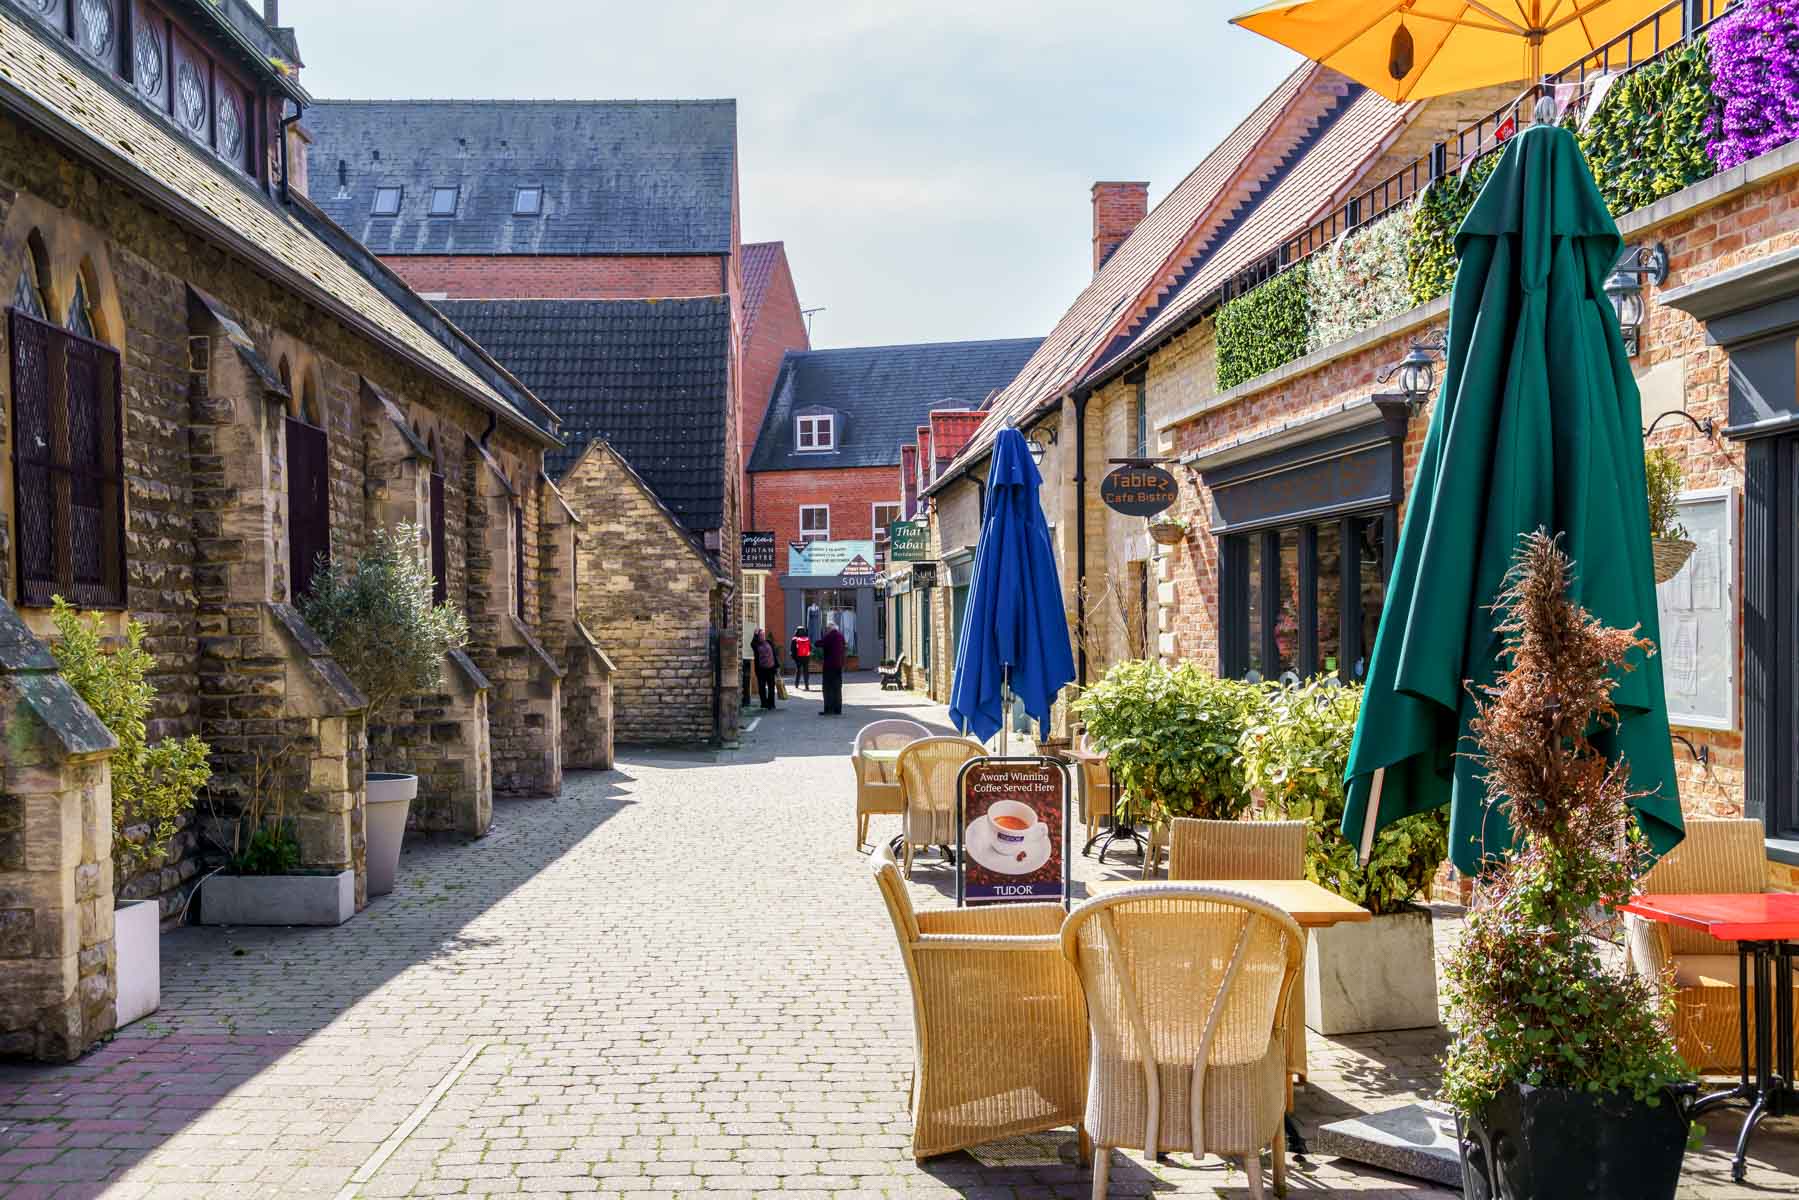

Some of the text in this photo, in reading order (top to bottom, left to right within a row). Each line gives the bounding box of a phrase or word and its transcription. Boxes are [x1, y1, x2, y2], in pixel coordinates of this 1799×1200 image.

[1138, 491, 1175, 503] Bistro
[980, 773, 1049, 783] Award Winning
[974, 783, 1055, 793] Coffee Served Here
[993, 885, 1033, 896] TUDOR
